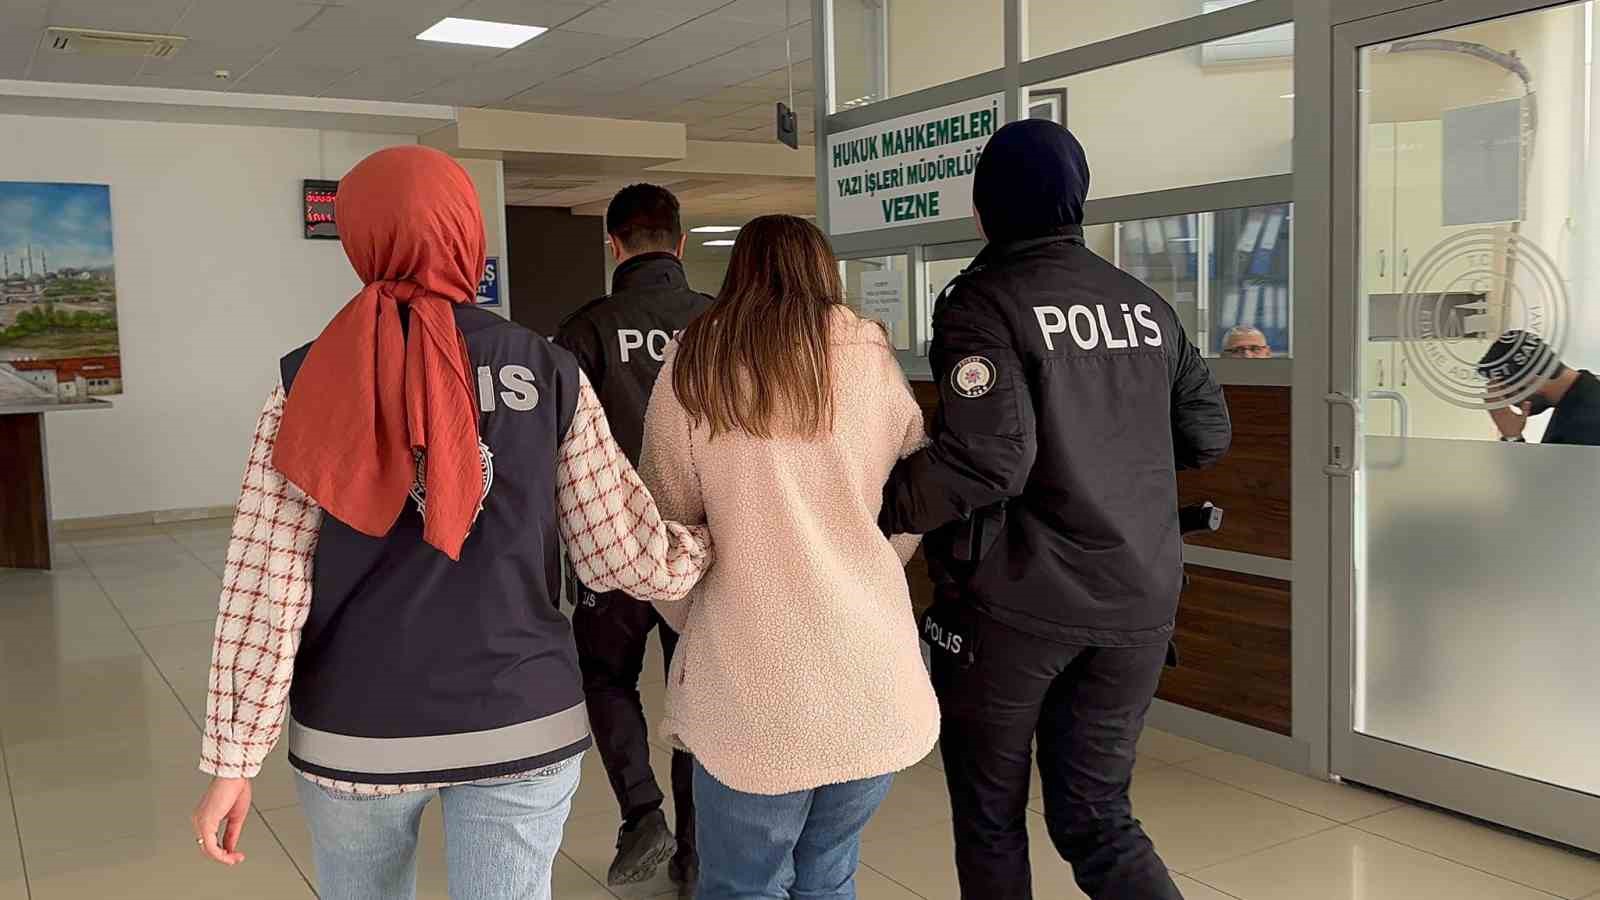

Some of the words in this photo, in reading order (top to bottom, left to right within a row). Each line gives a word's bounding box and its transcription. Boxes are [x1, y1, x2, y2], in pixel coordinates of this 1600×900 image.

[832, 135, 879, 168] HUKUK
[881, 100, 998, 157] MAHKEMELERİ
[837, 176, 862, 197] YAZI
[864, 162, 904, 197] İŞLERİ
[881, 191, 940, 223] VEZNE
